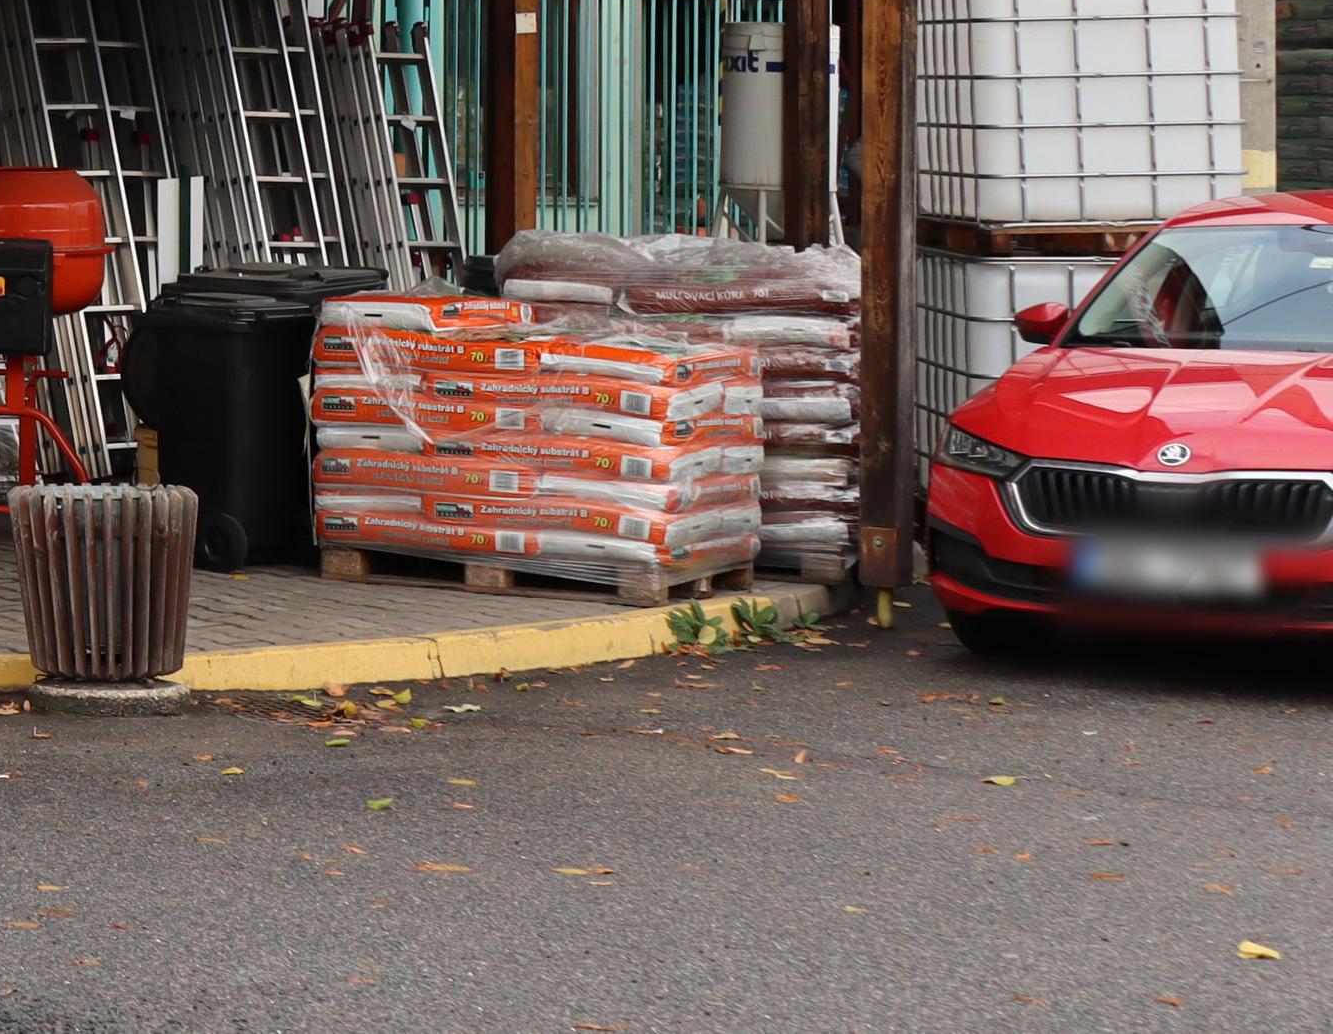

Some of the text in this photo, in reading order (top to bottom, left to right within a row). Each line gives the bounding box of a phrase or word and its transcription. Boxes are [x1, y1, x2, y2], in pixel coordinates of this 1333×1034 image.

[480, 382, 590, 396] Zahradnický substrát B
[480, 442, 539, 456] Zahradnický
[540, 446, 580, 458] substrát
[356, 457, 411, 471] Zahradnický
[412, 462, 449, 476] substrát
[480, 504, 589, 518] Zahradnický substrát B
[364, 516, 417, 530] Zahradnický
[419, 522, 455, 536] substrát
